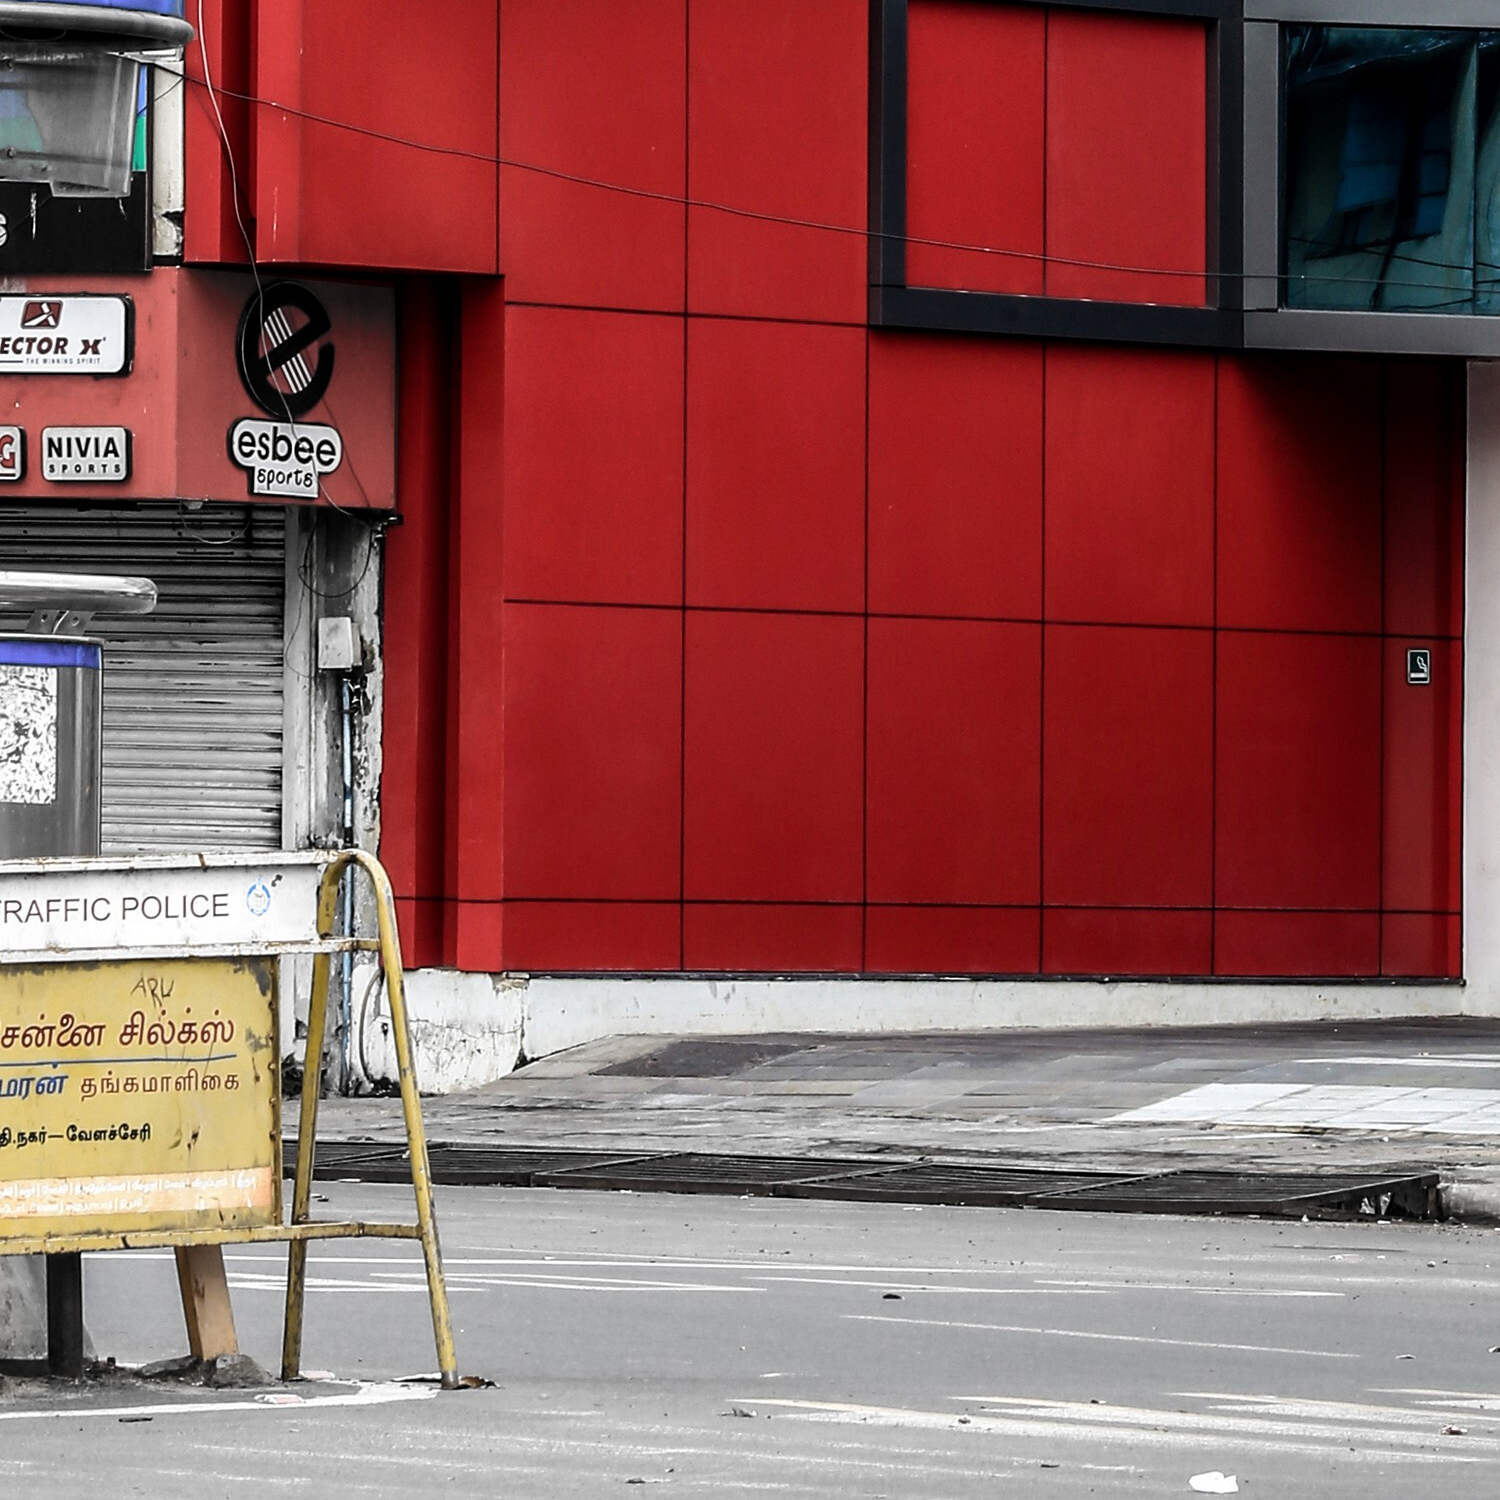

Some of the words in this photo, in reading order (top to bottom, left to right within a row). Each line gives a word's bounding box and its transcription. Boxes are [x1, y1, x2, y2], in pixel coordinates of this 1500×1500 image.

[0, 337, 68, 355] ECTOR
[47, 437, 120, 458] NIVIA
[238, 426, 336, 467] esbee
[48, 464, 121, 474] SPORTS
[257, 467, 313, 490] sports
[0, 897, 111, 923] RAFFIC
[122, 893, 229, 921] POLICE
